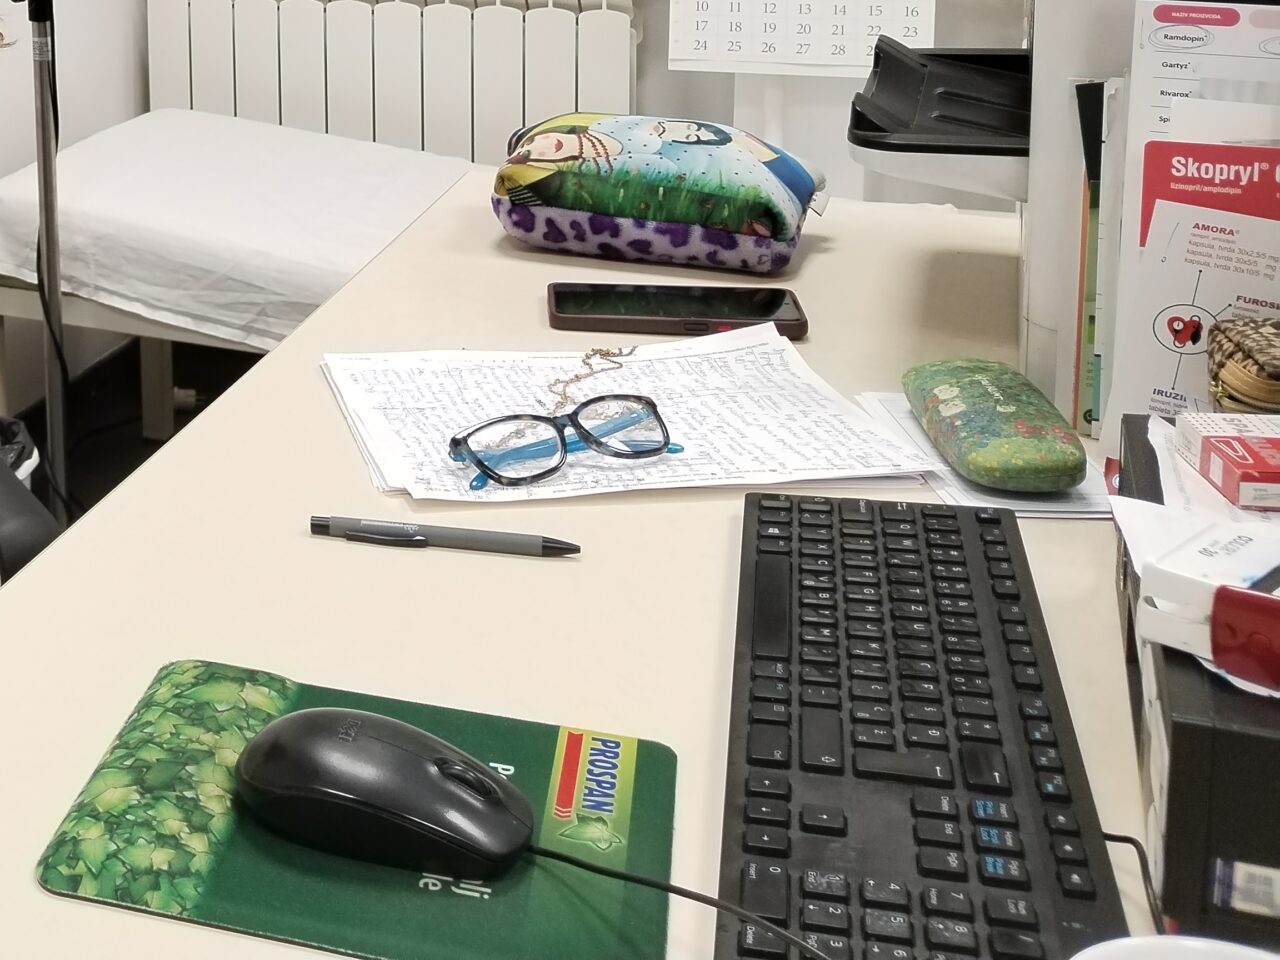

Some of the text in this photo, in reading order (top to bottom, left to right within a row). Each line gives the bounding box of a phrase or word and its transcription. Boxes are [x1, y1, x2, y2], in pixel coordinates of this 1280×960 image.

[696, 0, 919, 18] 10 11 12 13 14 15 16
[696, 20, 918, 38] 17 18 19 20 21 22 23
[694, 40, 846, 56] 24 25 26 27 28
[581, 737, 622, 814] PROSPAN
[950, 892, 964, 900] 7
[954, 925, 968, 933] 8
